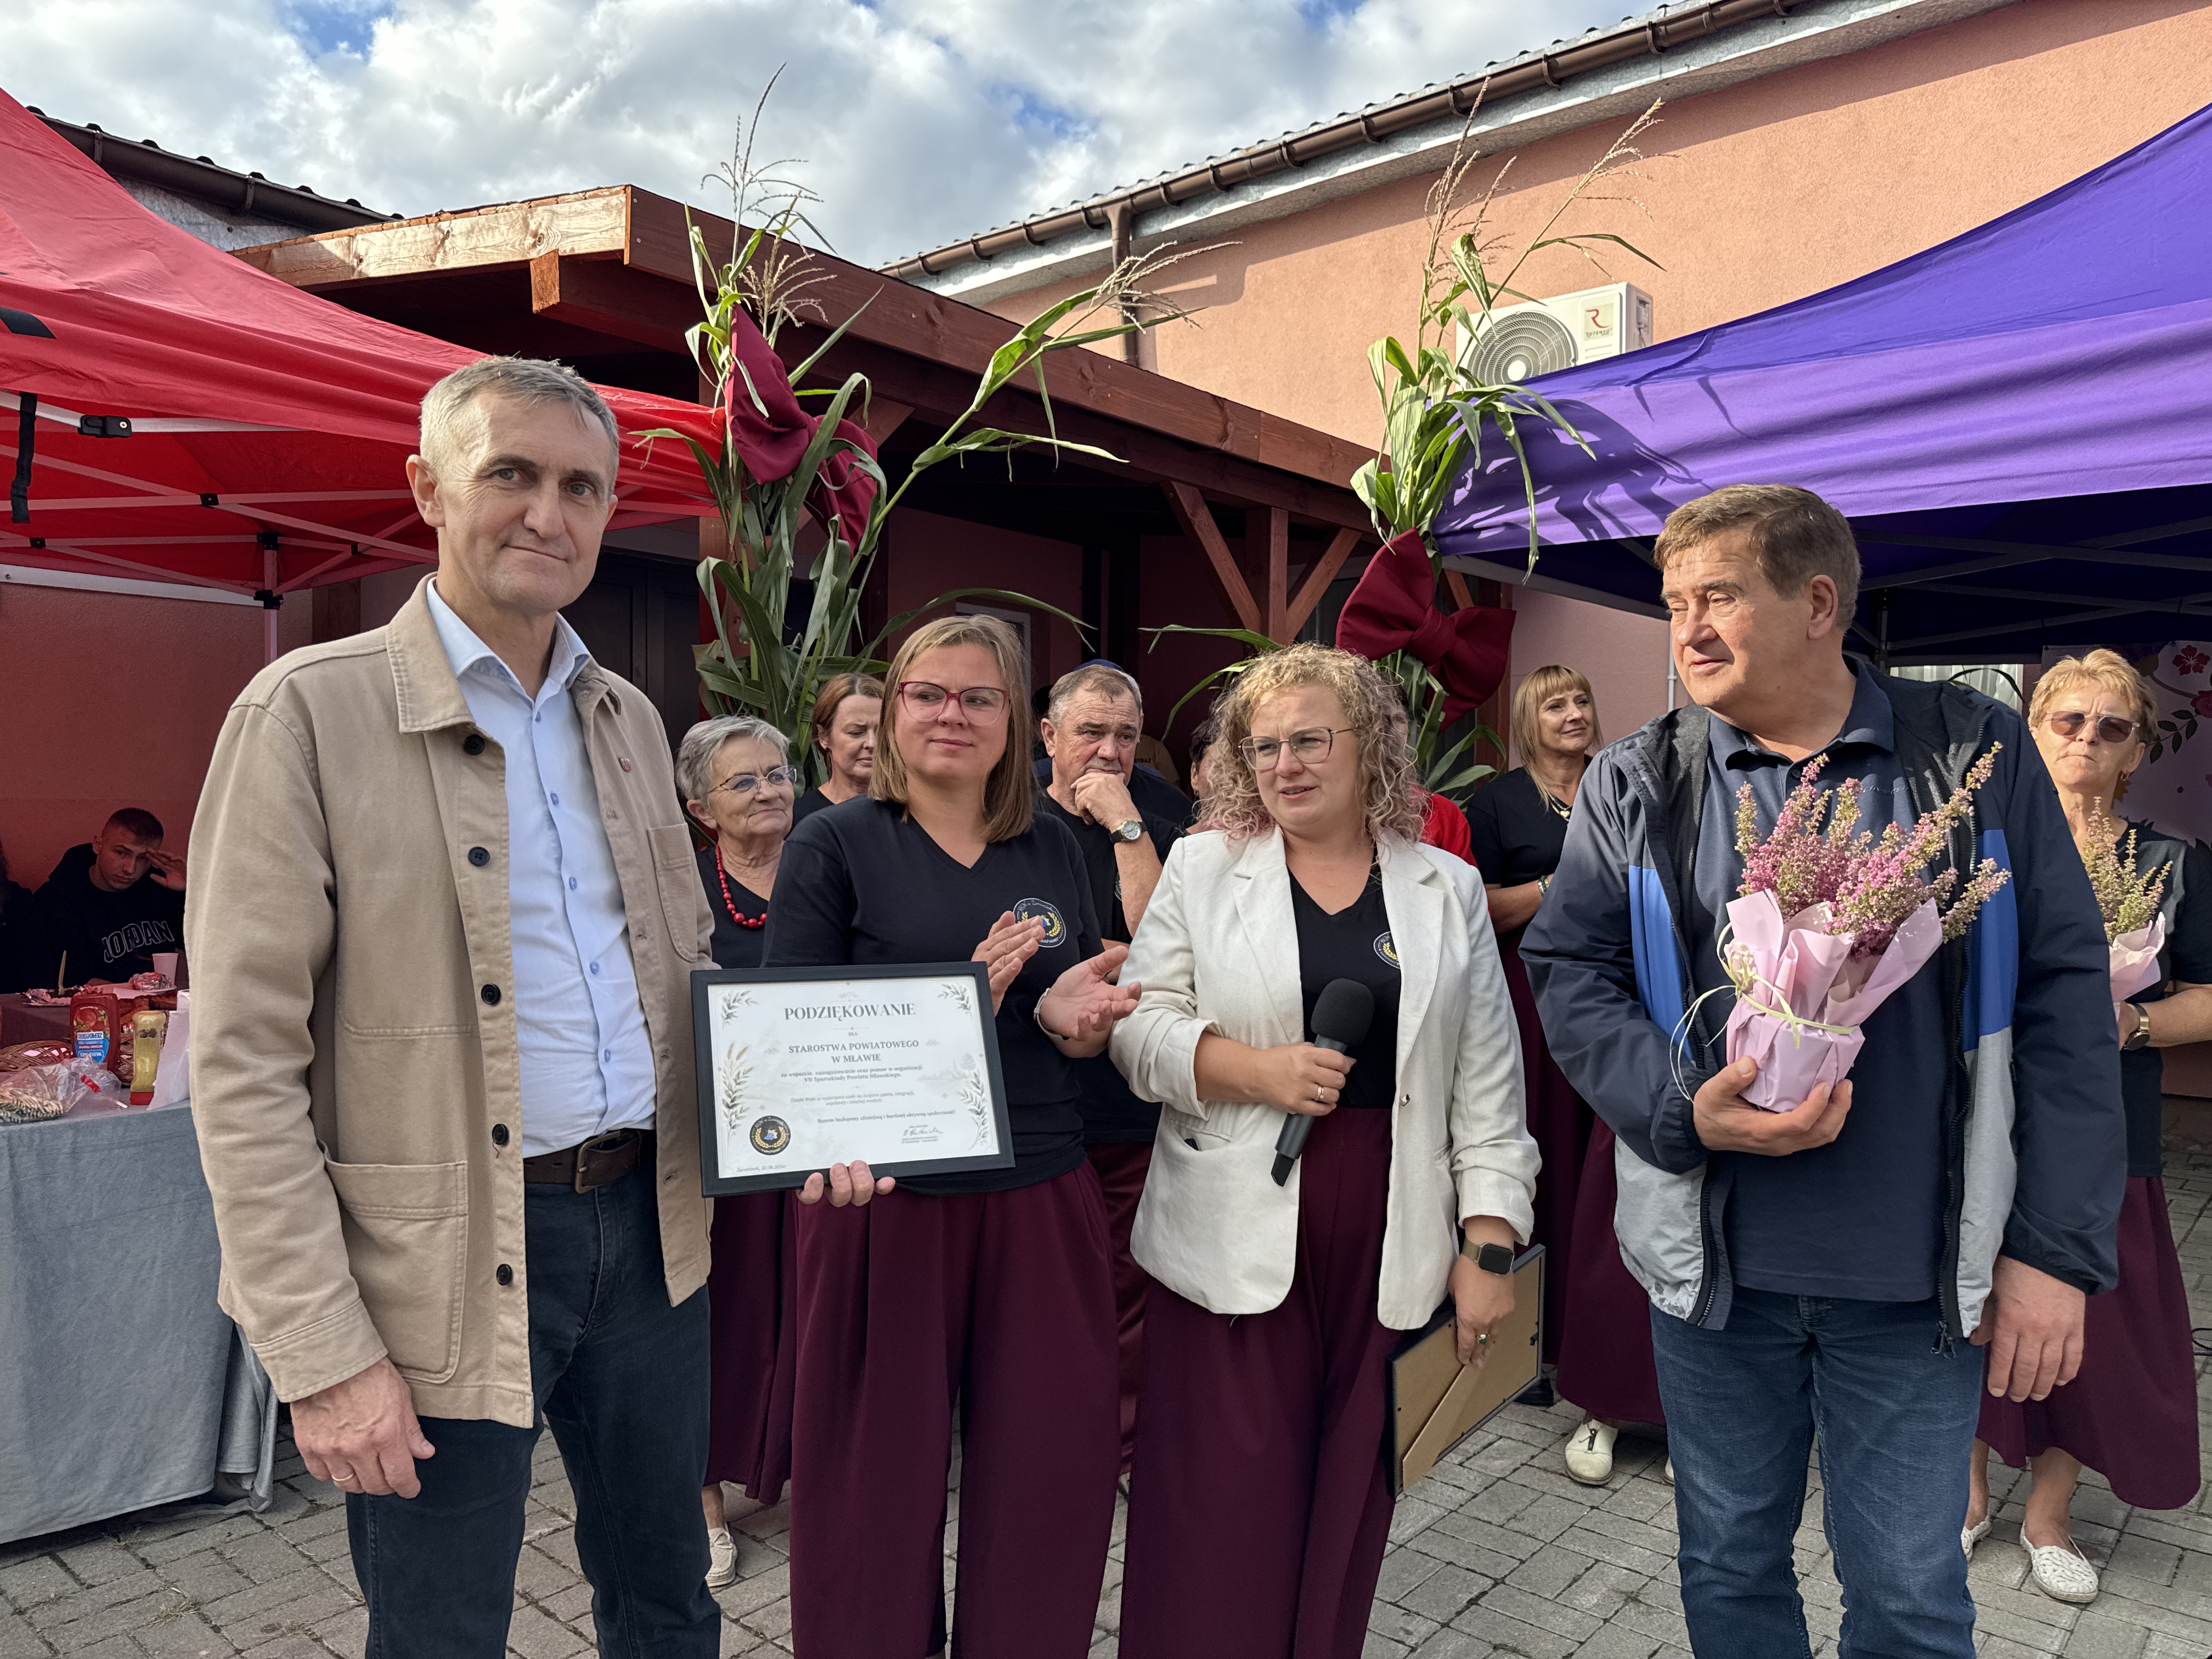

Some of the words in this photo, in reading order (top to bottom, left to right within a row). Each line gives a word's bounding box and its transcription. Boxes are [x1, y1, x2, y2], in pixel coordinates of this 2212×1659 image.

[101, 921, 175, 963] JORDAN
[784, 1003, 916, 1022] PODZIĘKOWANIE
[788, 1043, 847, 1053] STAROSTWA
[849, 1040, 919, 1051] POWIATOWEGO
[843, 1054, 881, 1063] MŁAWIE
